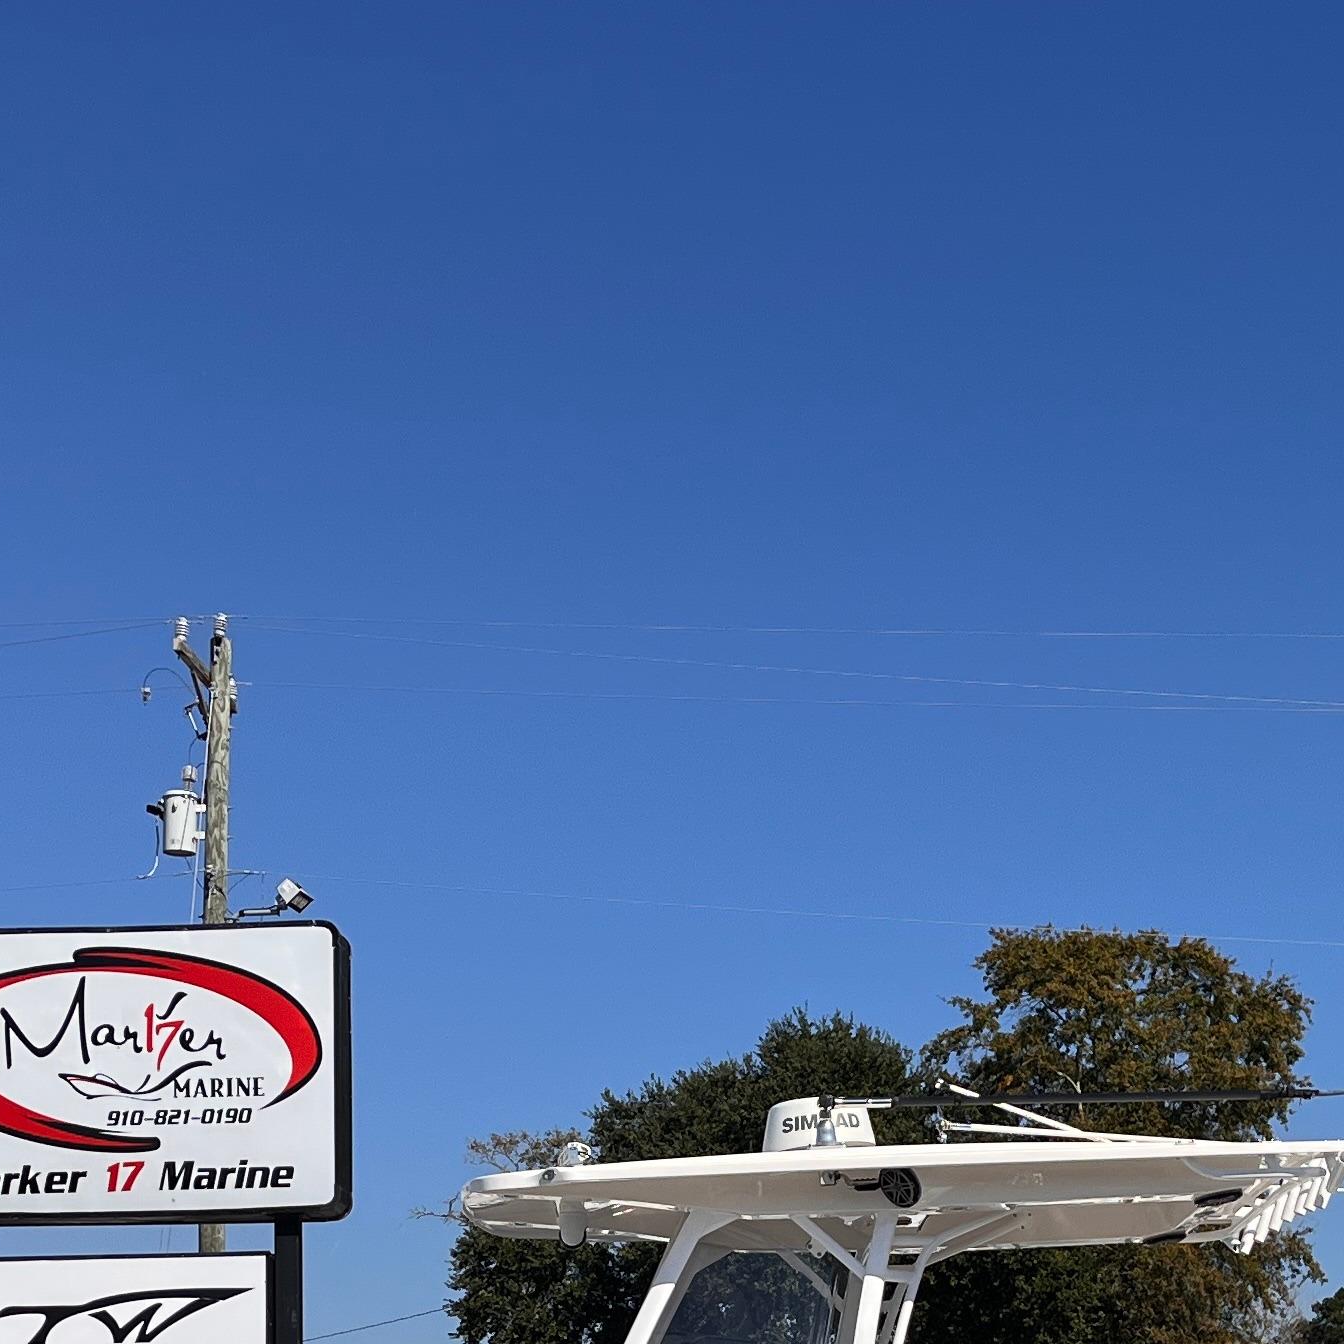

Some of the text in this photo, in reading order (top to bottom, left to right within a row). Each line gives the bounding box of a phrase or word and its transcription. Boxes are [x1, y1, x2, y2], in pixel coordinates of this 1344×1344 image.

[173, 1076, 265, 1098] MARINE
[106, 1108, 253, 1126] 910-821-0190
[782, 1113, 860, 1133] SIMAD
[107, 1161, 145, 1192] 17
[159, 1159, 295, 1191] Marine
